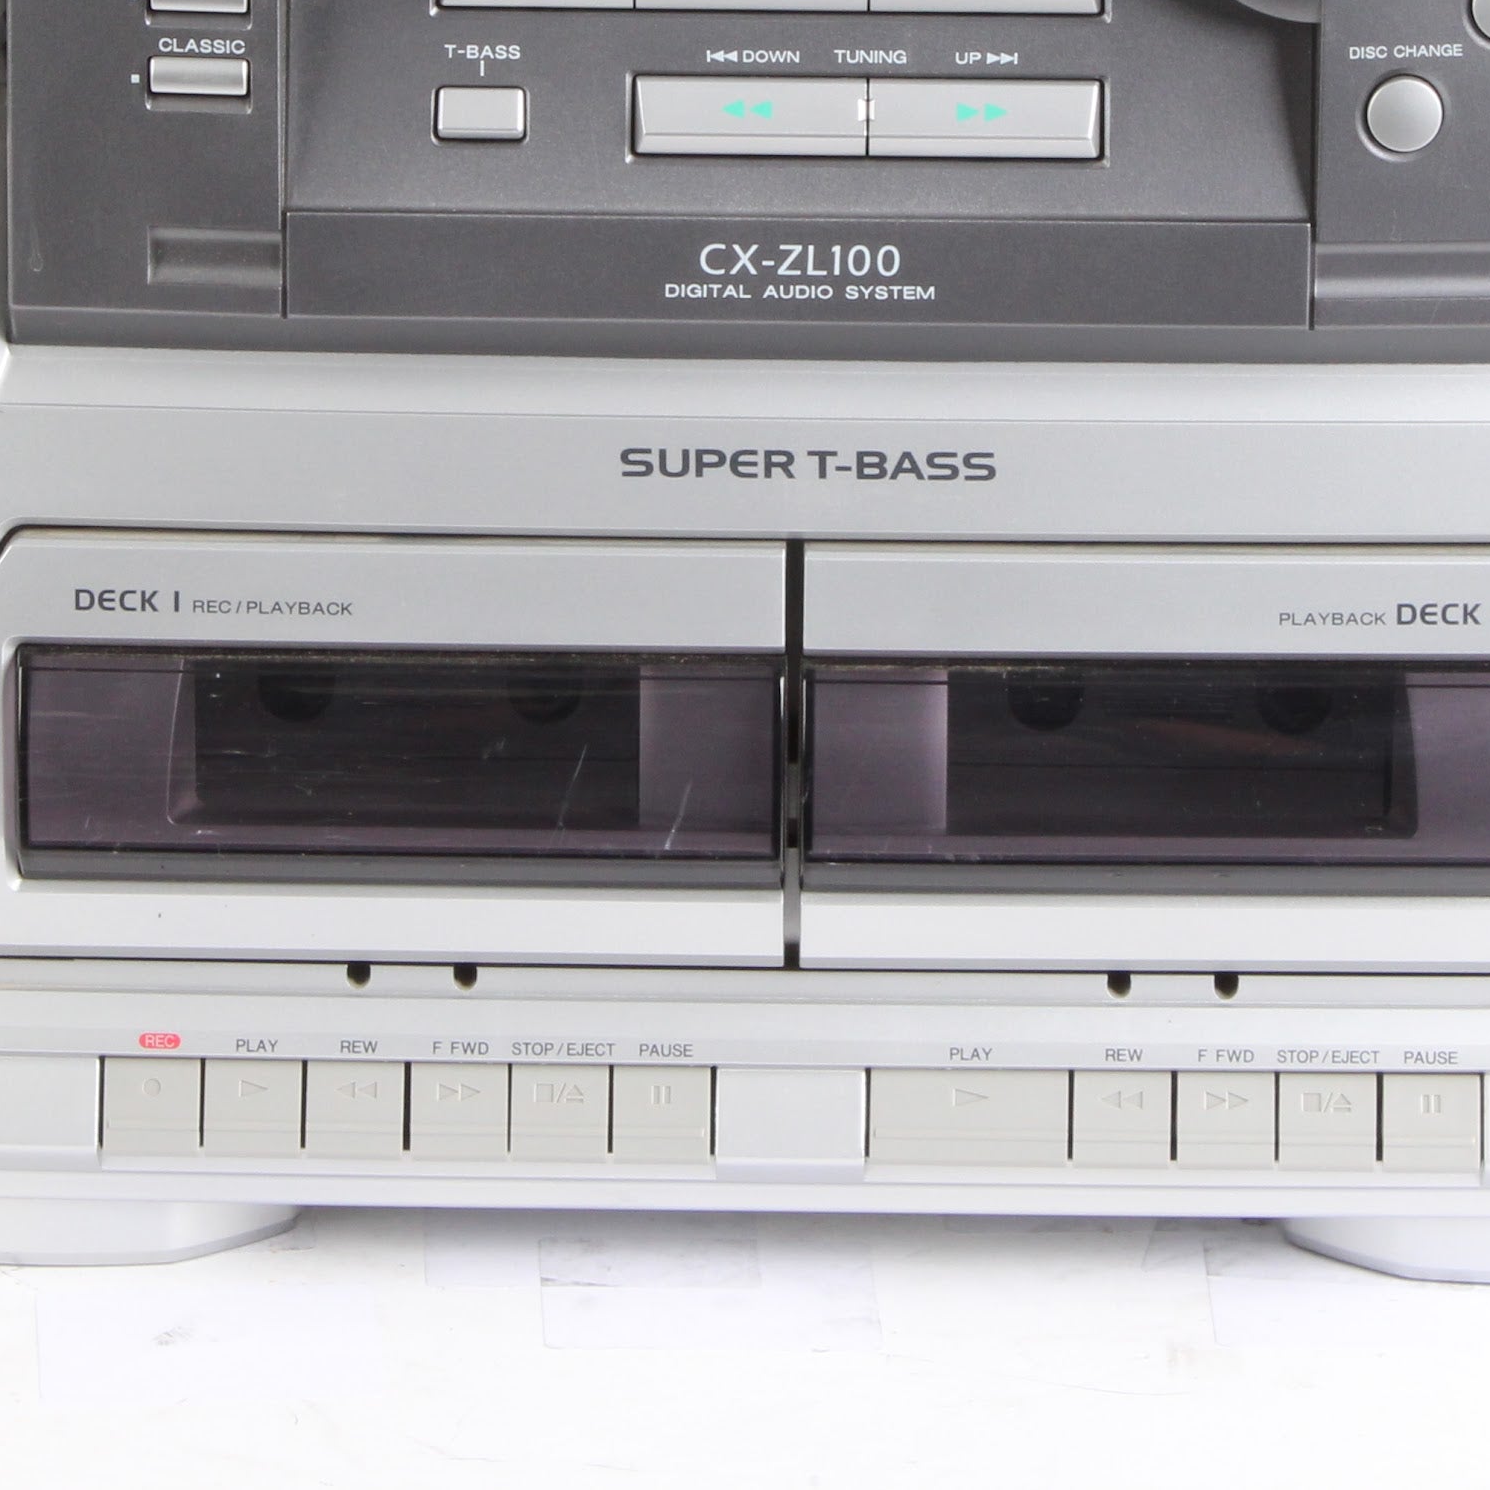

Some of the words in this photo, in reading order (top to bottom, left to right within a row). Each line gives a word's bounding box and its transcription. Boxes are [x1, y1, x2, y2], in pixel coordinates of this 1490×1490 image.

[158, 38, 246, 55] CLASSIC
[444, 44, 521, 60] T-BASS
[1349, 45, 1388, 60] DISC
[1393, 43, 1464, 59] CHANGE
[742, 49, 800, 64] DOWN
[833, 49, 908, 65] TUNING
[955, 51, 982, 65] UP
[699, 243, 901, 277] CX-ZL100
[664, 283, 752, 299] DIGITAL
[762, 284, 834, 300] AUDIO
[844, 285, 935, 301] SYSTEM
[619, 447, 796, 479] SUPER
[806, 450, 997, 482] T-BASS
[74, 588, 159, 613] DECK
[192, 599, 353, 616] REC/PLAYBACK
[1278, 611, 1386, 627] PLAYBACK
[1396, 603, 1481, 626] DECK
[144, 1032, 177, 1051] REC
[235, 1038, 279, 1053] PLAY
[340, 1039, 378, 1055] REW
[432, 1040, 443, 1055] F
[450, 1041, 490, 1056] FWD
[638, 1043, 693, 1058] PAUSE
[949, 1046, 993, 1062] PLAY
[1104, 1048, 1143, 1063] REW
[1197, 1048, 1208, 1063] F
[1215, 1048, 1255, 1064] FWD
[1404, 1051, 1459, 1065] PAUSE
